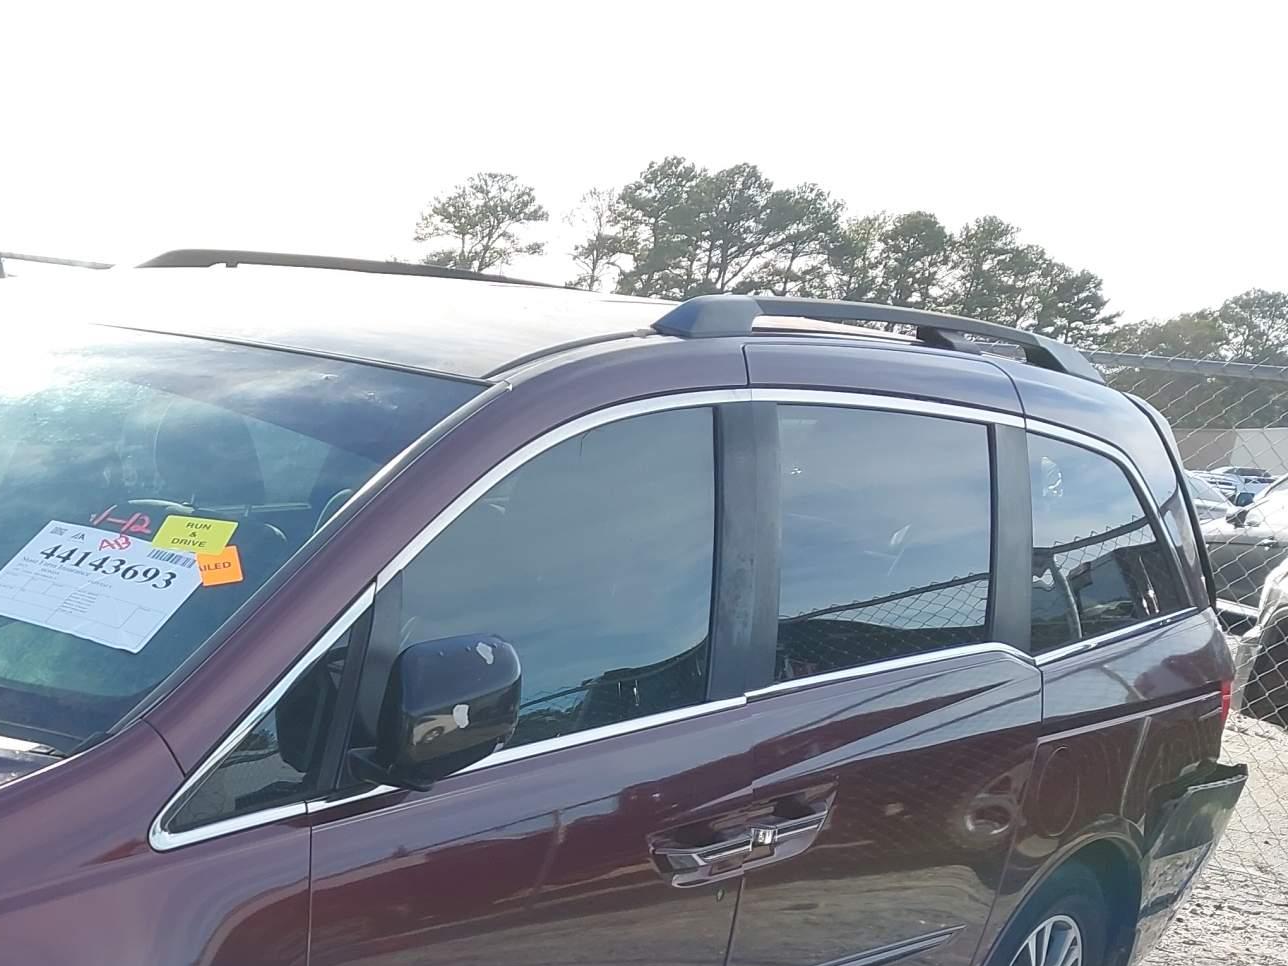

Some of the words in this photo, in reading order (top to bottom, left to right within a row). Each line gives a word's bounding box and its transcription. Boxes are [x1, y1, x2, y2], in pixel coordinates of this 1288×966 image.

[185, 521, 212, 531] RUN
[171, 538, 208, 548] DRIVE
[40, 543, 177, 590] 44143693
